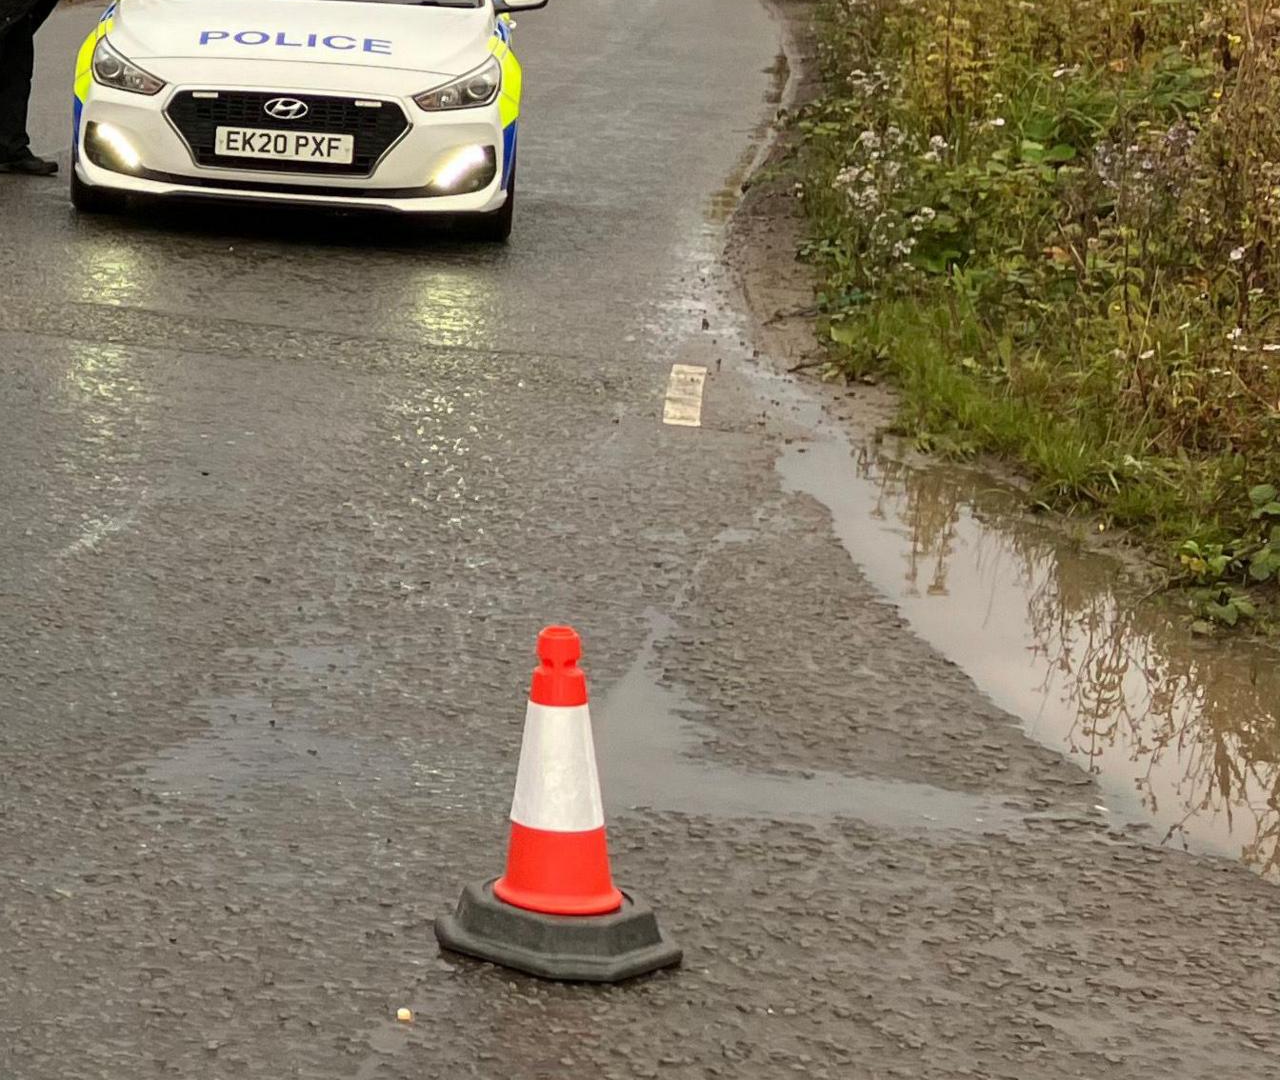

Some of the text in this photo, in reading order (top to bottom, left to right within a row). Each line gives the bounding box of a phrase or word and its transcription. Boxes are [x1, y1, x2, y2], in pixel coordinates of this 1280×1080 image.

[199, 30, 392, 56] POLICE
[226, 130, 342, 158] EK20 PXF
